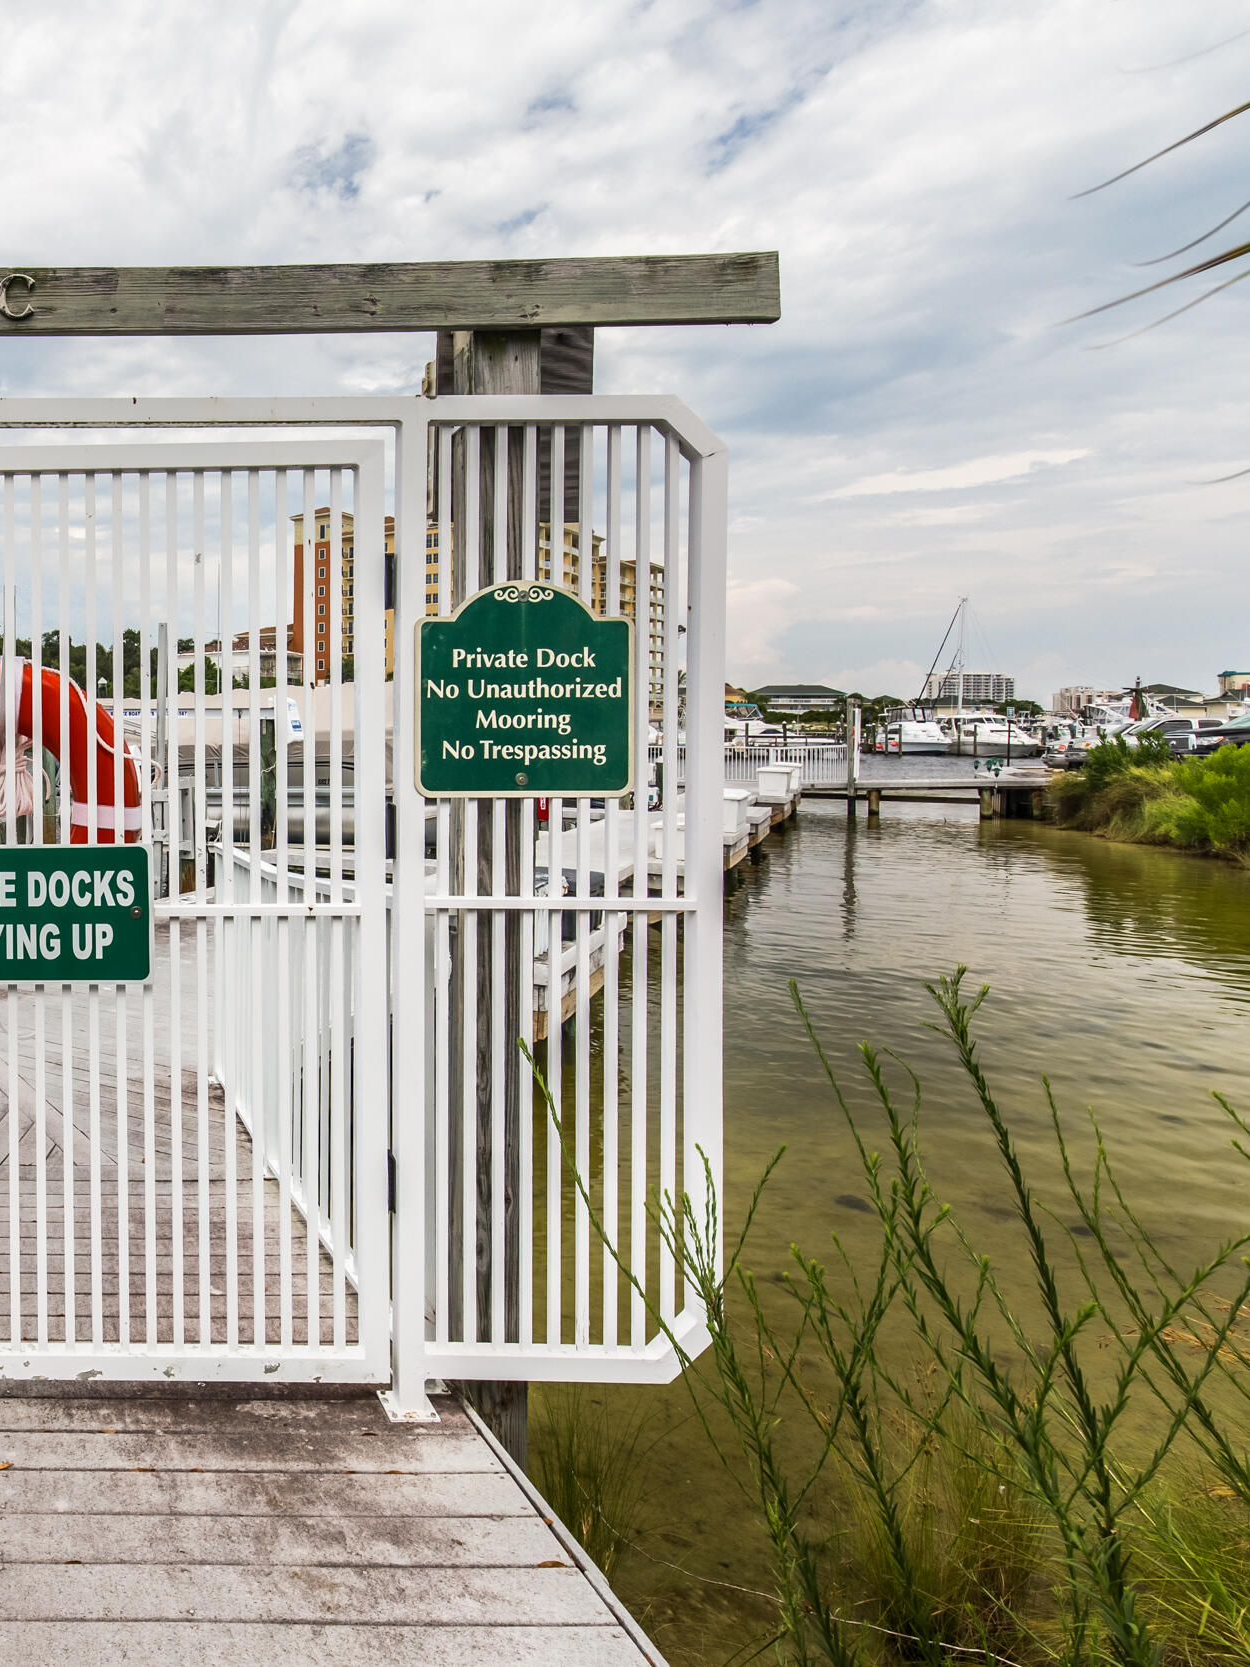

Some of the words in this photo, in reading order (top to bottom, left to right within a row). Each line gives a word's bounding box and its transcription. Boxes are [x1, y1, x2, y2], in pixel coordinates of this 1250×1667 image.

[452, 648, 528, 668] Private
[536, 647, 596, 668] Dock
[427, 680, 459, 699] No
[467, 677, 622, 699] Unauthorized
[475, 708, 572, 735] Mooring
[442, 740, 474, 760] No
[479, 738, 607, 766] Trespassing
[27, 870, 135, 907] DOCKS
[72, 923, 114, 960] UP
